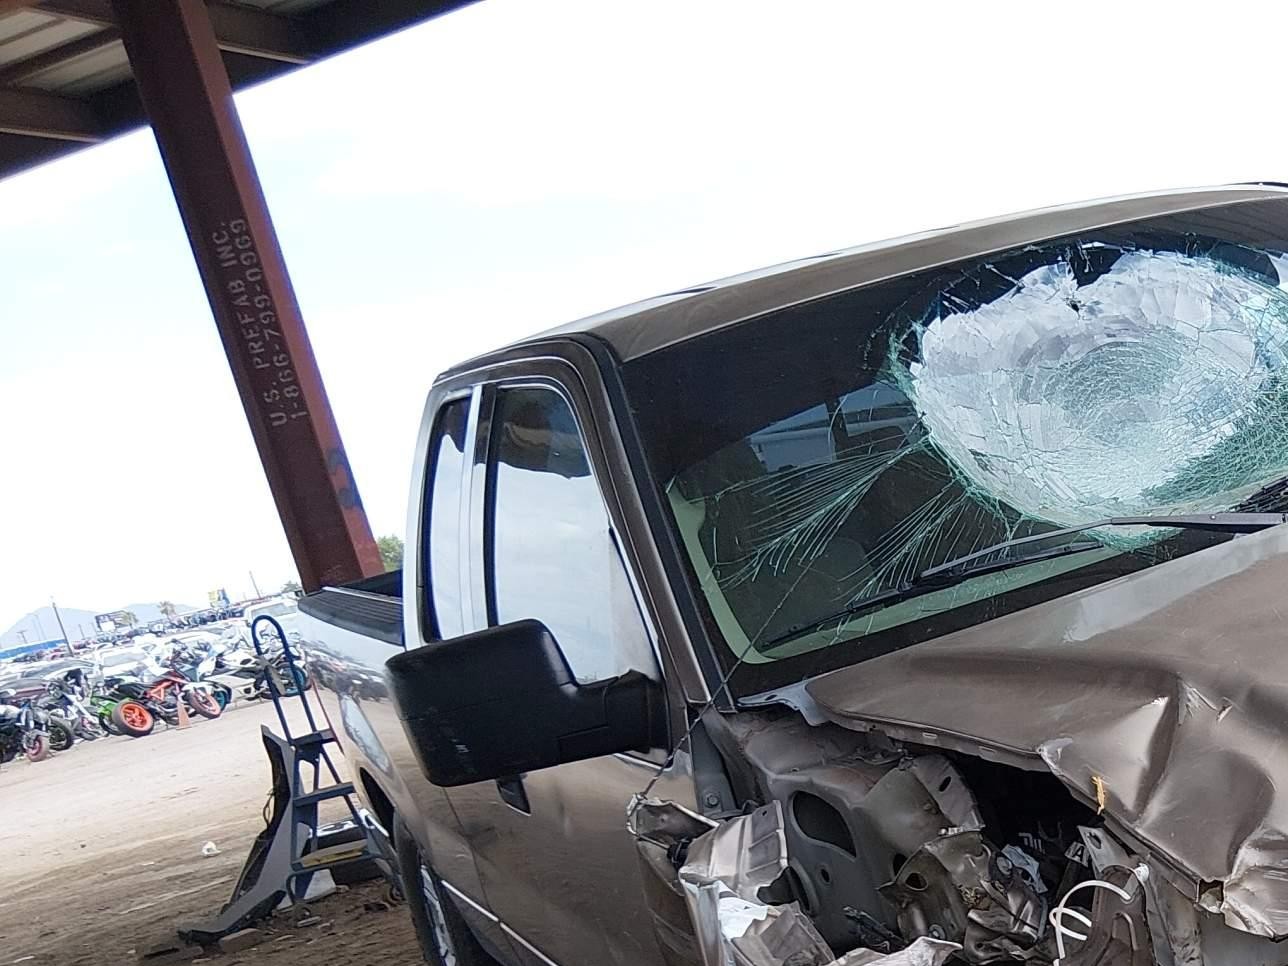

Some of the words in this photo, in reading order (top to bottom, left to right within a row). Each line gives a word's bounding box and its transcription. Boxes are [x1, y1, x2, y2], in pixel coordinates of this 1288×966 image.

[212, 222, 238, 267] INC.
[230, 281, 270, 369] PREFAB
[264, 382, 288, 426] U.S.
